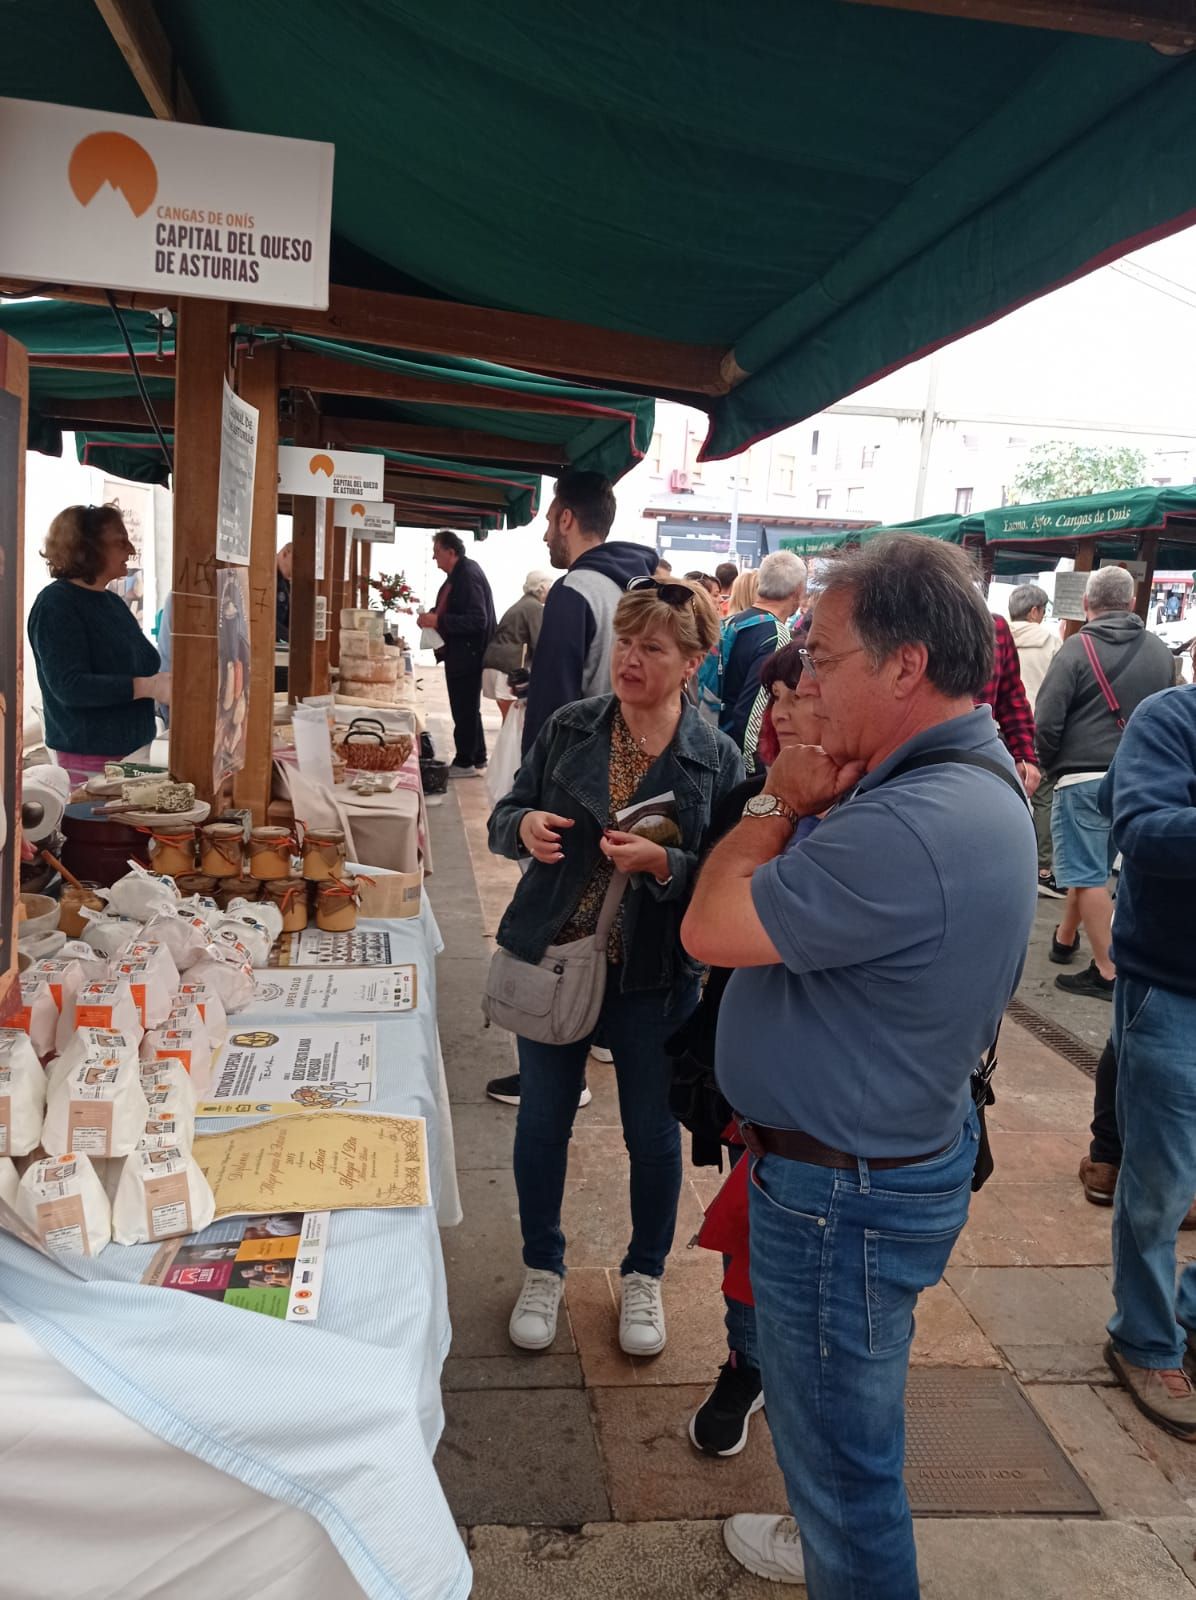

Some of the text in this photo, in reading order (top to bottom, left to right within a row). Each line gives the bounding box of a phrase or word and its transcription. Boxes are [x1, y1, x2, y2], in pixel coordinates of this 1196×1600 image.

[156, 205, 255, 229] CANGAS DE ONÍS
[156, 222, 313, 263] CAPITAL DEL QUESO
[155, 250, 260, 284] DE ASTURIAS
[333, 479, 352, 487] CAPITAL
[363, 481, 378, 489] QUESO
[340, 487, 363, 495] ASTURIAS
[1055, 511, 1093, 532] Cangas
[1094, 509, 1105, 524] de
[290, 976, 302, 992] GOLD
